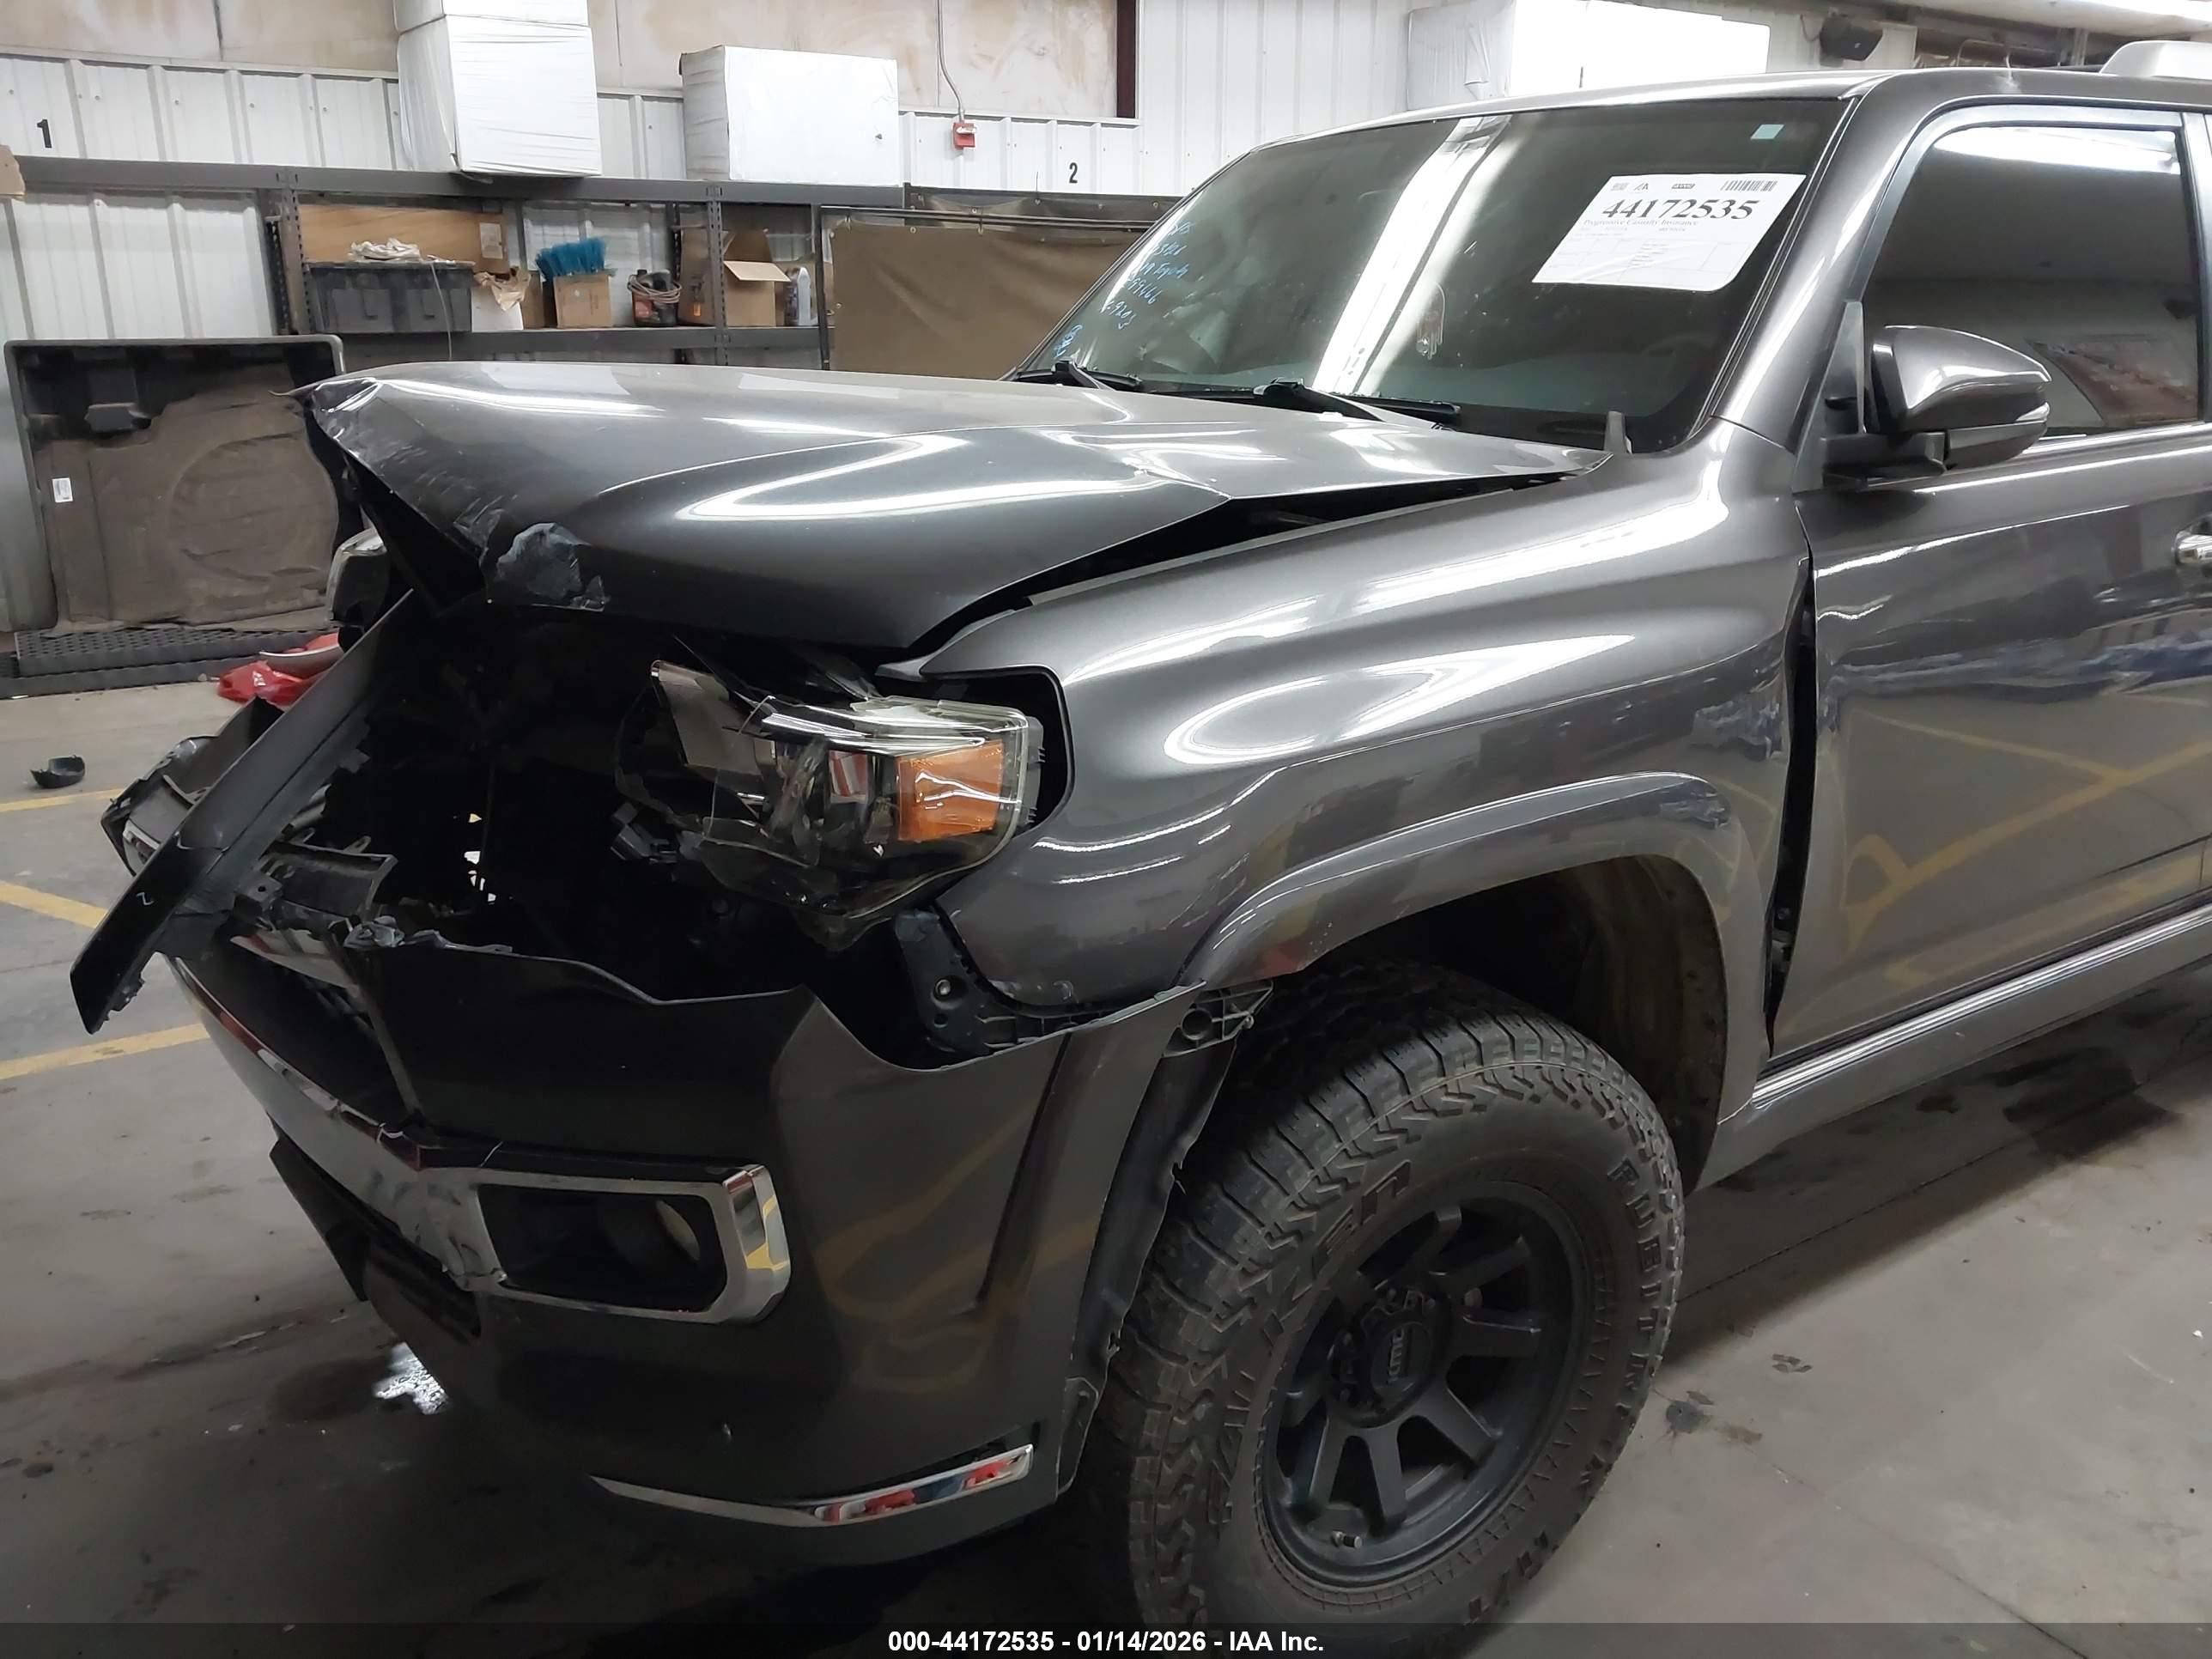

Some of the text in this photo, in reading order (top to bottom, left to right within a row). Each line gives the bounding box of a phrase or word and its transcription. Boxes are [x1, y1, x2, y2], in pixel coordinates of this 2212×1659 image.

[37, 119, 52, 149] 1
[1069, 162, 1079, 184] 2
[1602, 199, 1760, 219] 44172535
